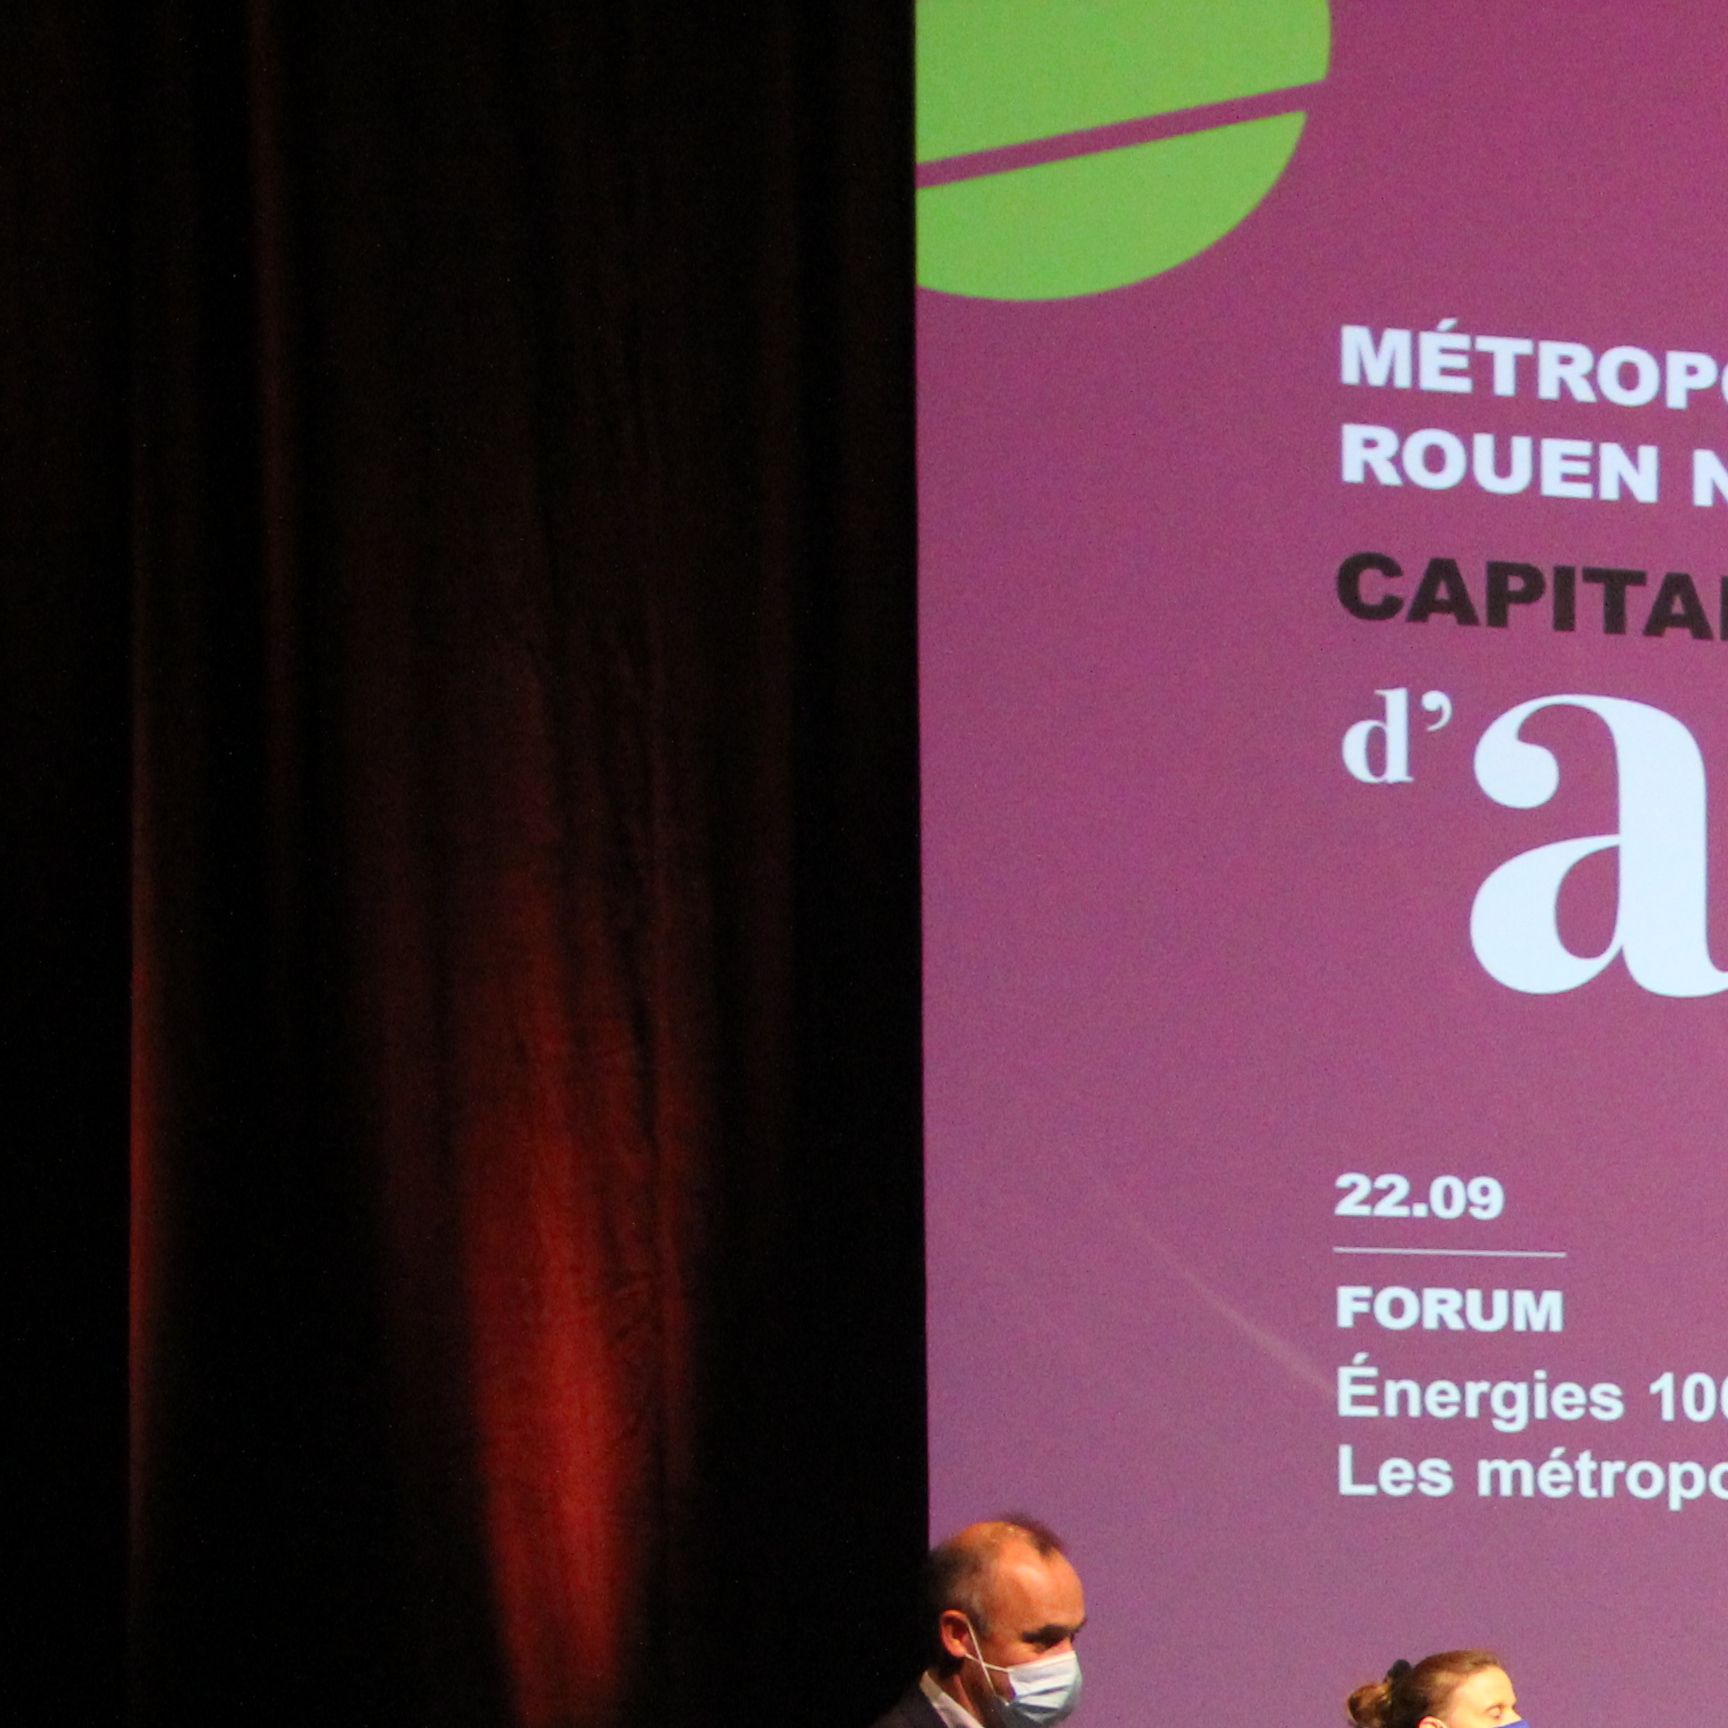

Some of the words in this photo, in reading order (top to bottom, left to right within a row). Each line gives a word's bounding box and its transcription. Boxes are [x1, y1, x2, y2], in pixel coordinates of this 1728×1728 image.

[1342, 423, 1659, 504] ROUEN
[1334, 1172, 1505, 1221] 22.09
[1336, 1285, 1564, 1333] FORUM
[1337, 1352, 1625, 1433] Énergies
[1338, 1444, 1455, 1498] Les
